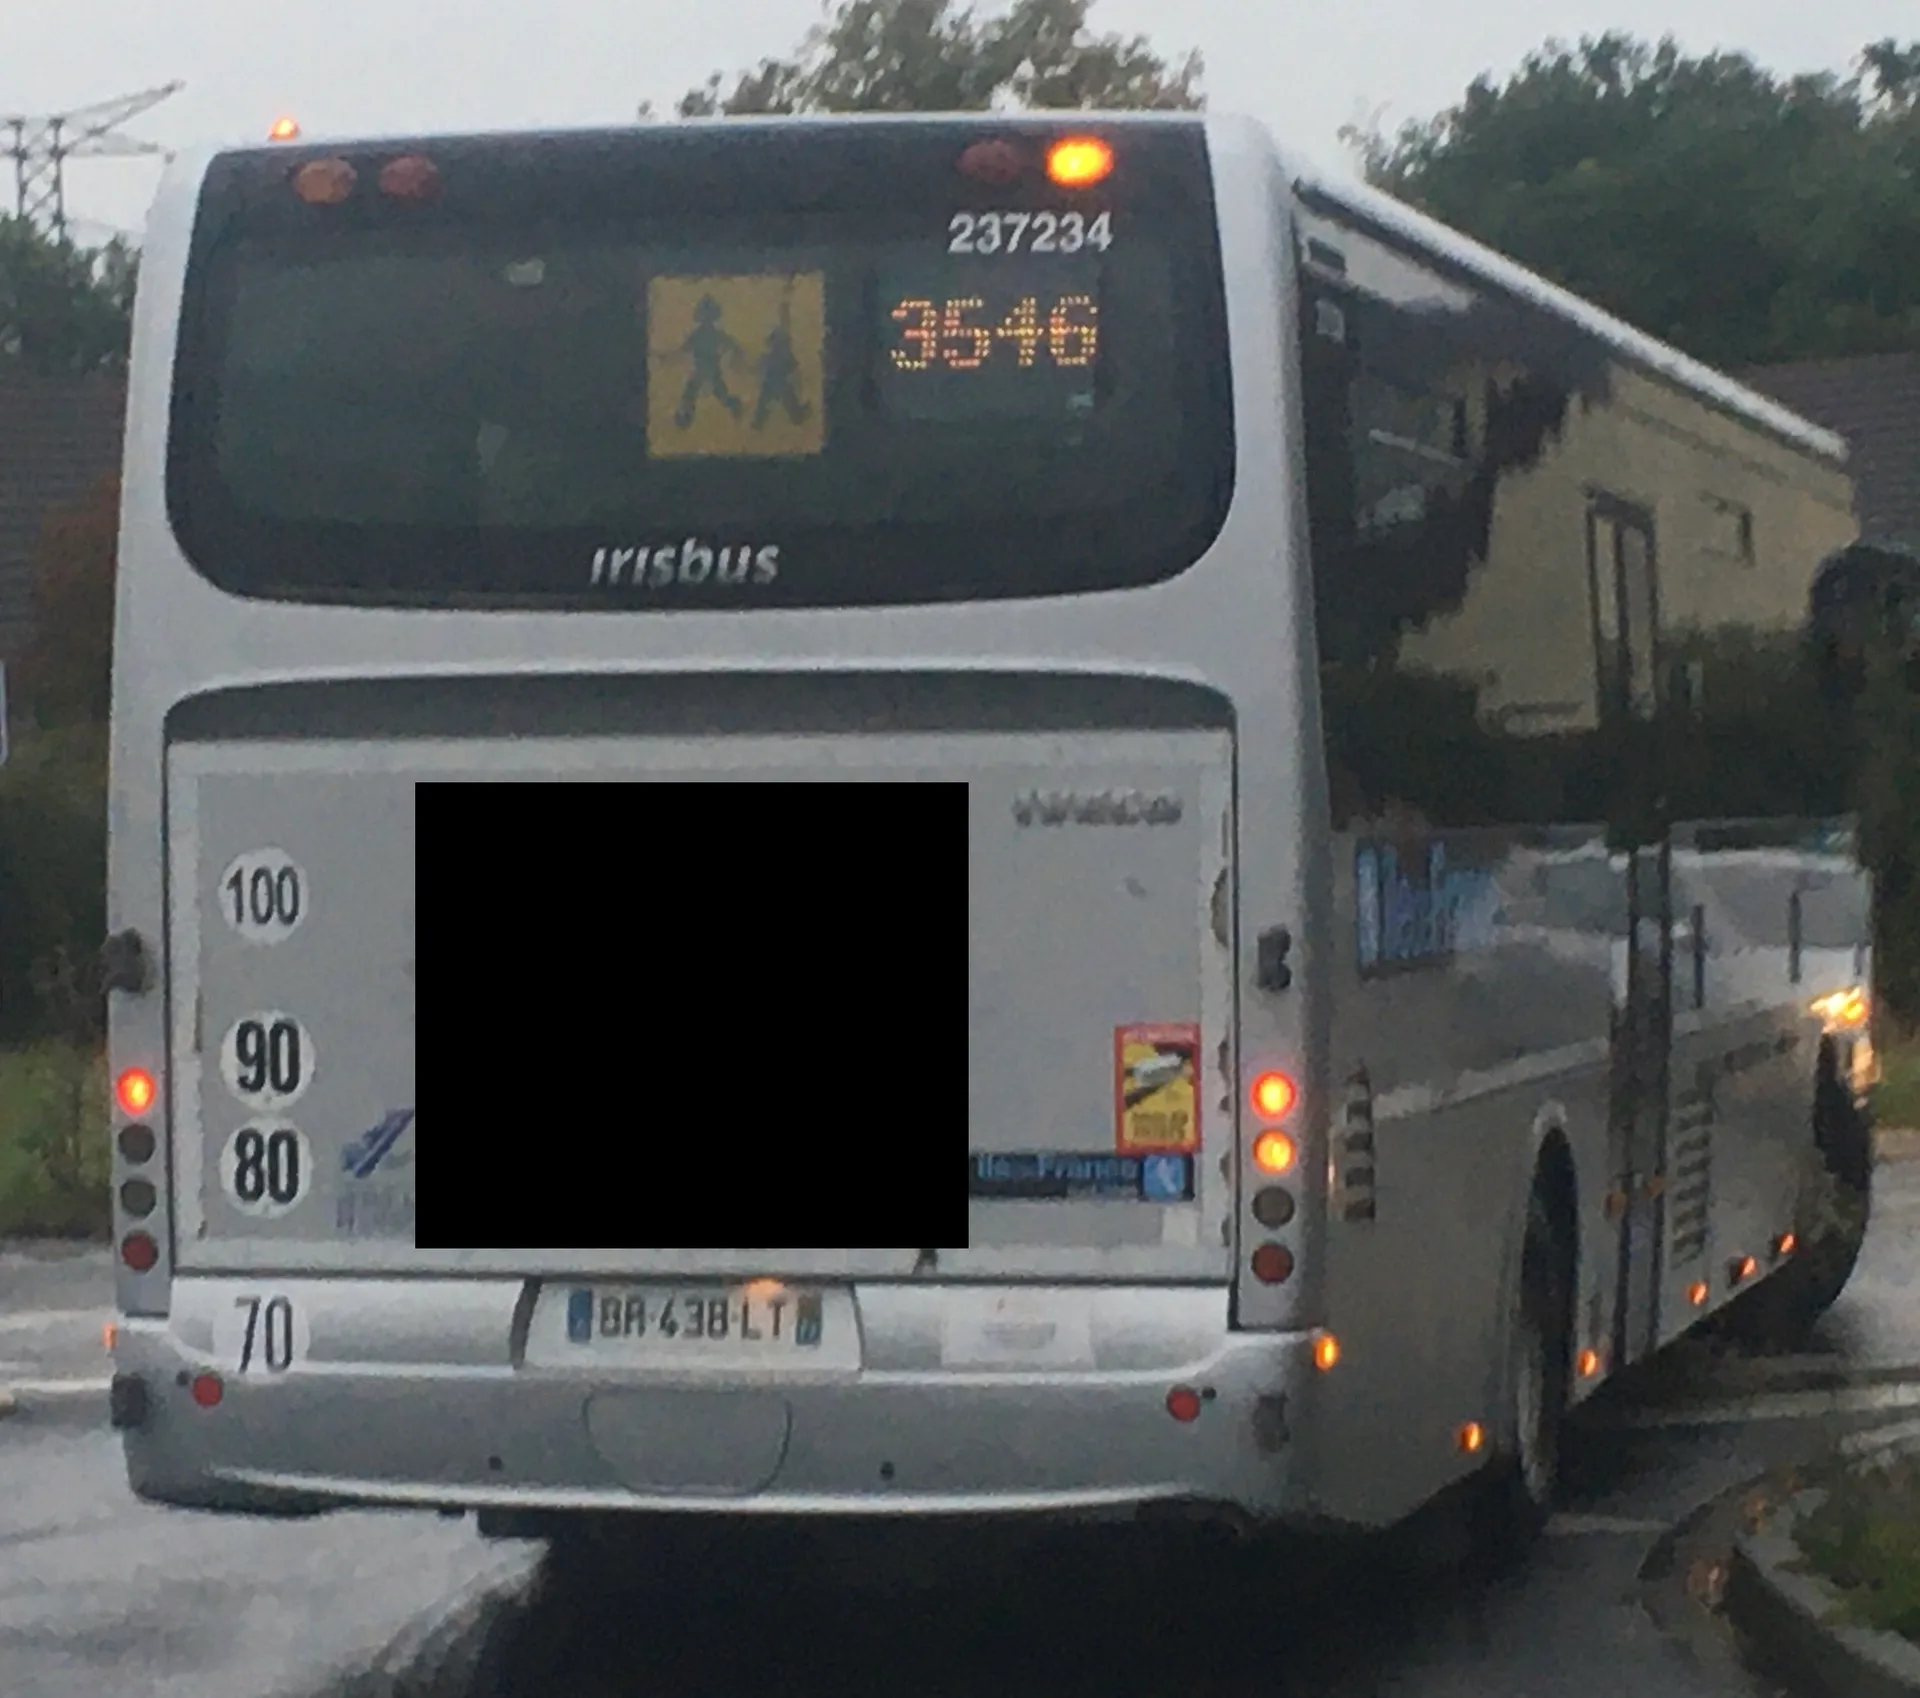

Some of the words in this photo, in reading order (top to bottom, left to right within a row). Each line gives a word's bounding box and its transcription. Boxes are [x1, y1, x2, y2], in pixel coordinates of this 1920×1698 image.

[948, 211, 1112, 254] 237234
[890, 296, 1096, 369] 3546
[227, 865, 299, 926] 100
[236, 1019, 300, 1095] 90
[234, 1127, 299, 1204] 80
[234, 1296, 292, 1372] 70
